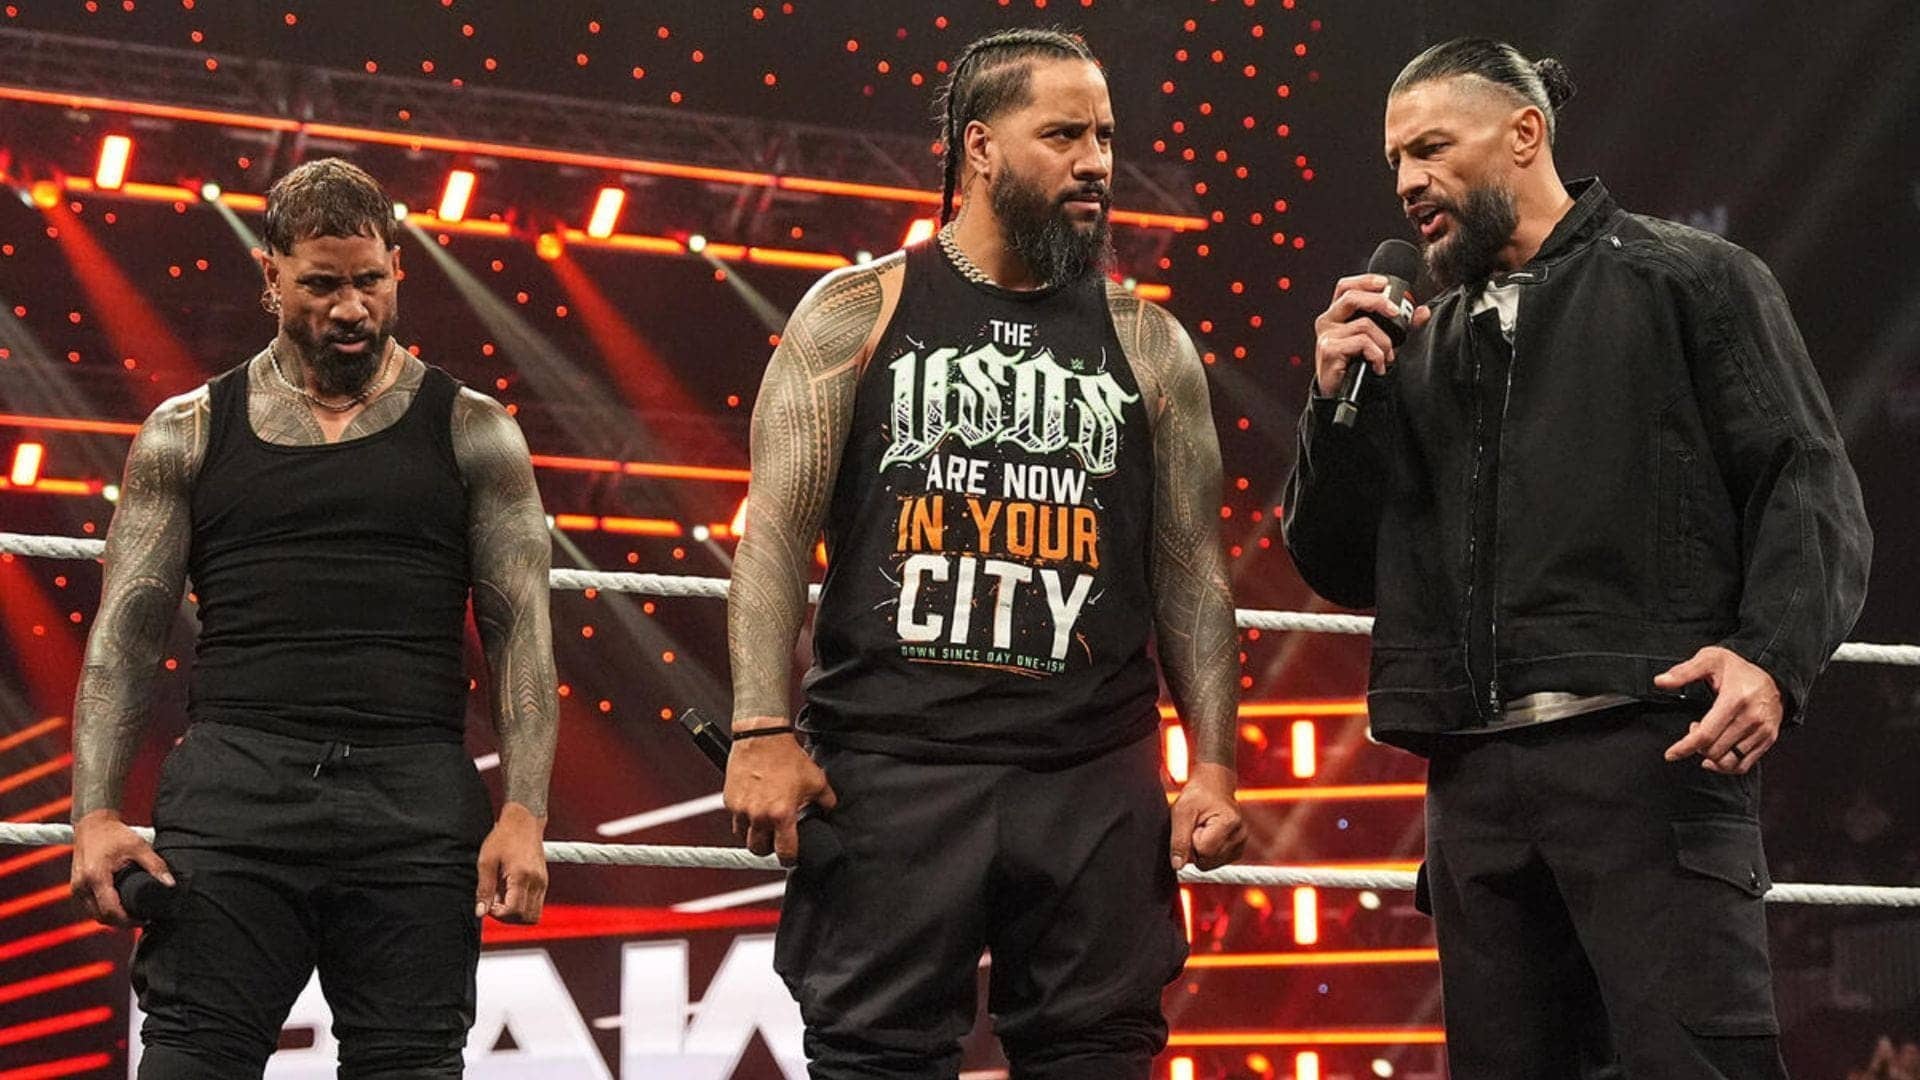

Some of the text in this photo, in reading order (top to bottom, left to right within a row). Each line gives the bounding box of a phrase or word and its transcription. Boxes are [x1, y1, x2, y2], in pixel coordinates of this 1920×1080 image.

[990, 320, 1033, 347] THE
[879, 343, 1139, 474] USOS
[926, 455, 1087, 505] ARE NOW
[897, 496, 1099, 568] IN YOUR
[897, 554, 1094, 660] CITY
[901, 645, 1066, 673] DOWN SINCE DAY ONE-ISH
